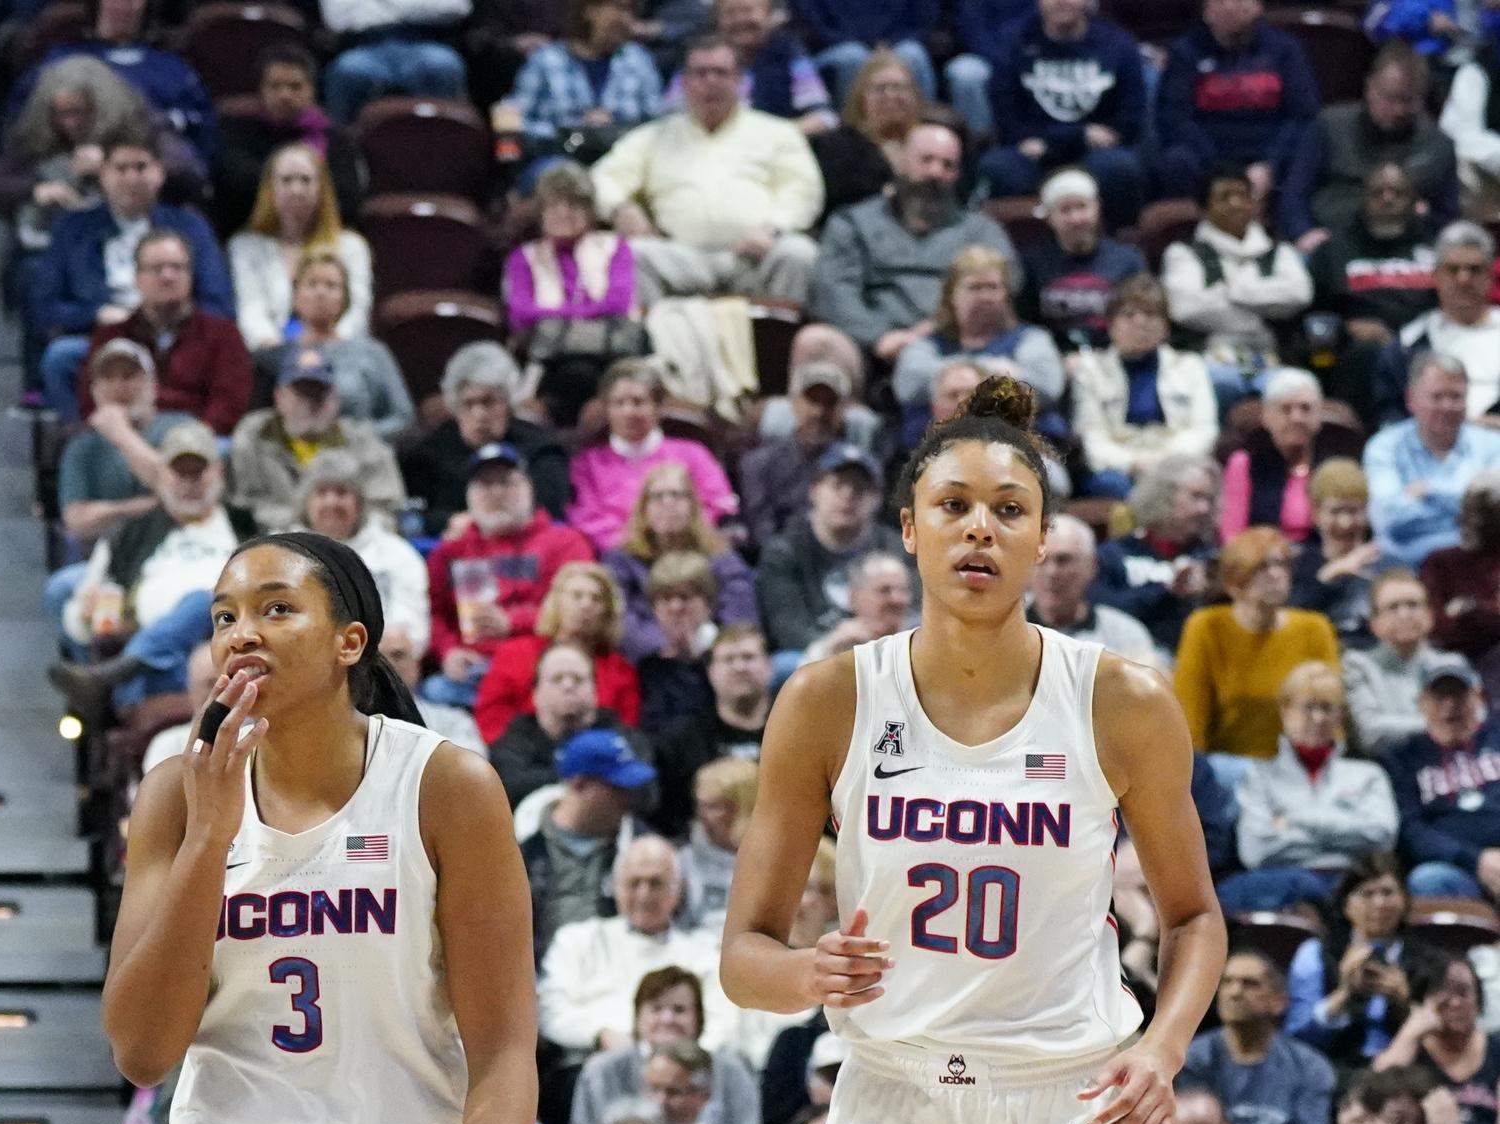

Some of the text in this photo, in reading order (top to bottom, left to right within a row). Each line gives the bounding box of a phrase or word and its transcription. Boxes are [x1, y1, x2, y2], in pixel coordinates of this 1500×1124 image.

[867, 795, 1071, 848] UCONN
[907, 862, 1020, 960] 20
[269, 956, 323, 1053] 3
[939, 1075, 975, 1085] UCONN
